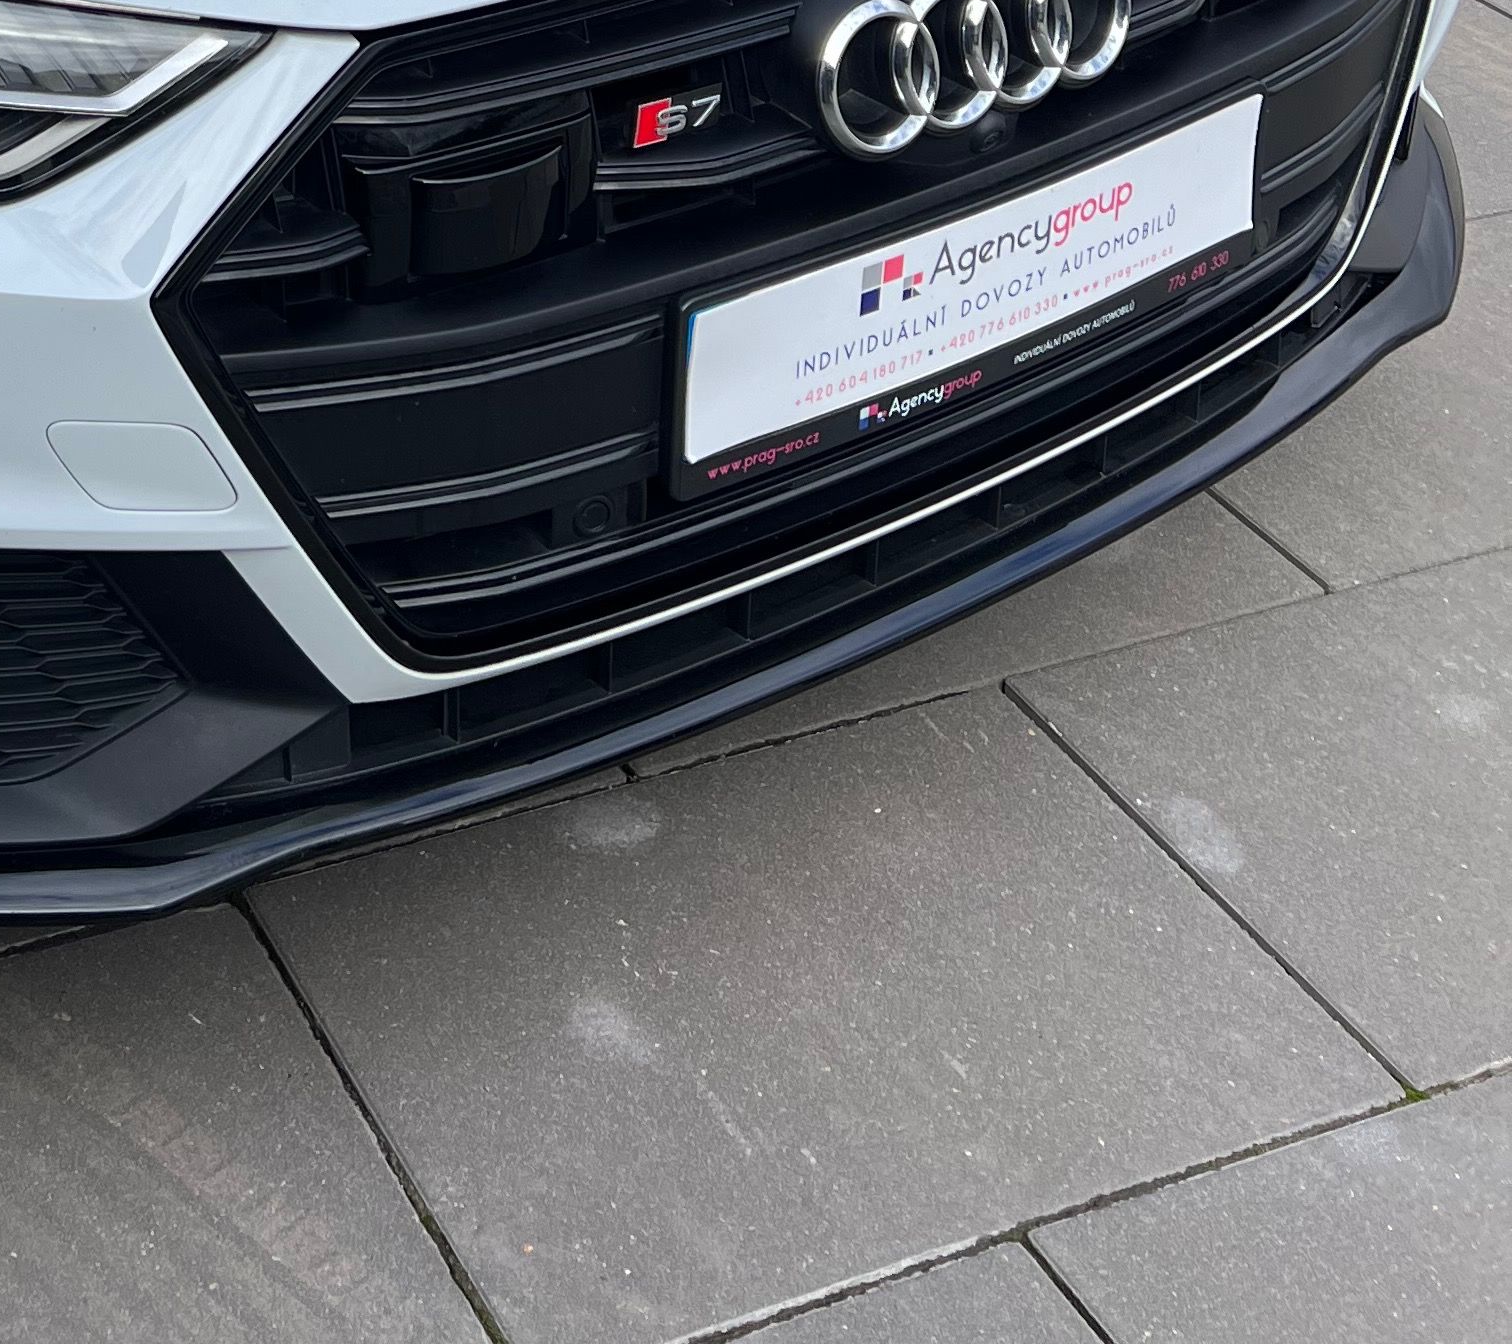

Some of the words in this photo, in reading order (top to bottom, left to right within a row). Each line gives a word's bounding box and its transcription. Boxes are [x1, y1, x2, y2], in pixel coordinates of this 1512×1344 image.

[654, 94, 721, 136] S7
[929, 181, 1134, 285] Agencygroup
[795, 304, 947, 379] INDIVIDUÁLNÍ
[960, 266, 1047, 318] DOVOZY
[1059, 203, 1177, 278] AUTOMOBILŮ
[1167, 272, 1187, 294] 776
[1190, 261, 1208, 282] 610
[1210, 250, 1230, 271] 330
[794, 383, 834, 407] +420
[838, 370, 868, 393] 604
[872, 360, 896, 380] 180
[900, 350, 923, 369] 717
[941, 329, 975, 352] +420
[979, 318, 1005, 339] 776
[1008, 307, 1031, 326] 610
[1034, 294, 1058, 315] 330
[888, 368, 983, 417] Agencygroup
[707, 431, 820, 480] www.prag-sro.cz
